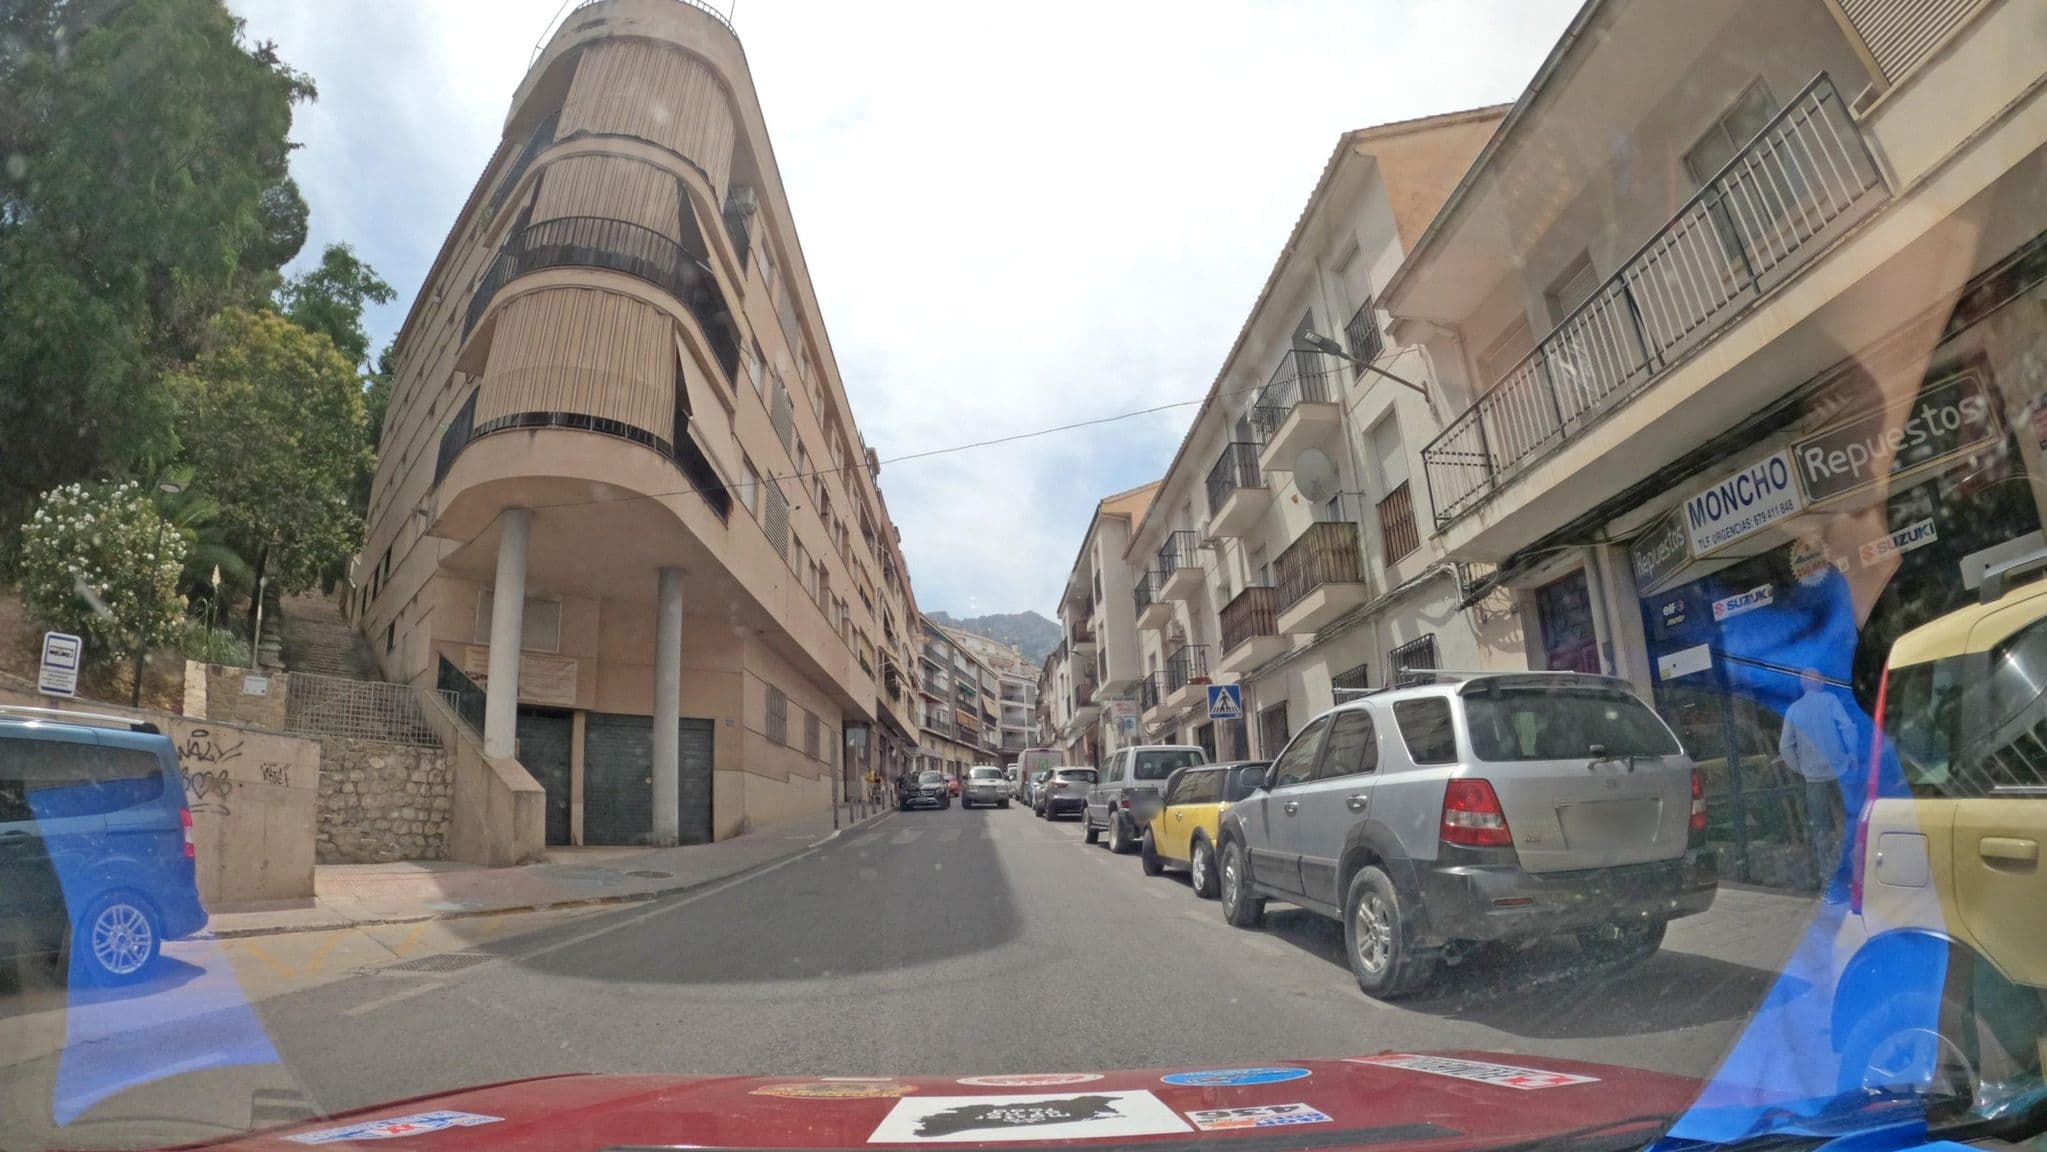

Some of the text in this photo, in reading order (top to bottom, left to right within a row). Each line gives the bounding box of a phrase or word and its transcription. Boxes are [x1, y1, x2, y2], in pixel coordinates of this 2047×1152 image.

[1804, 396, 1981, 483] Repuestos
[1688, 457, 1788, 531] MONCHO
[1635, 525, 1685, 577] Repuestos
[1876, 519, 1936, 553] SUZUKI
